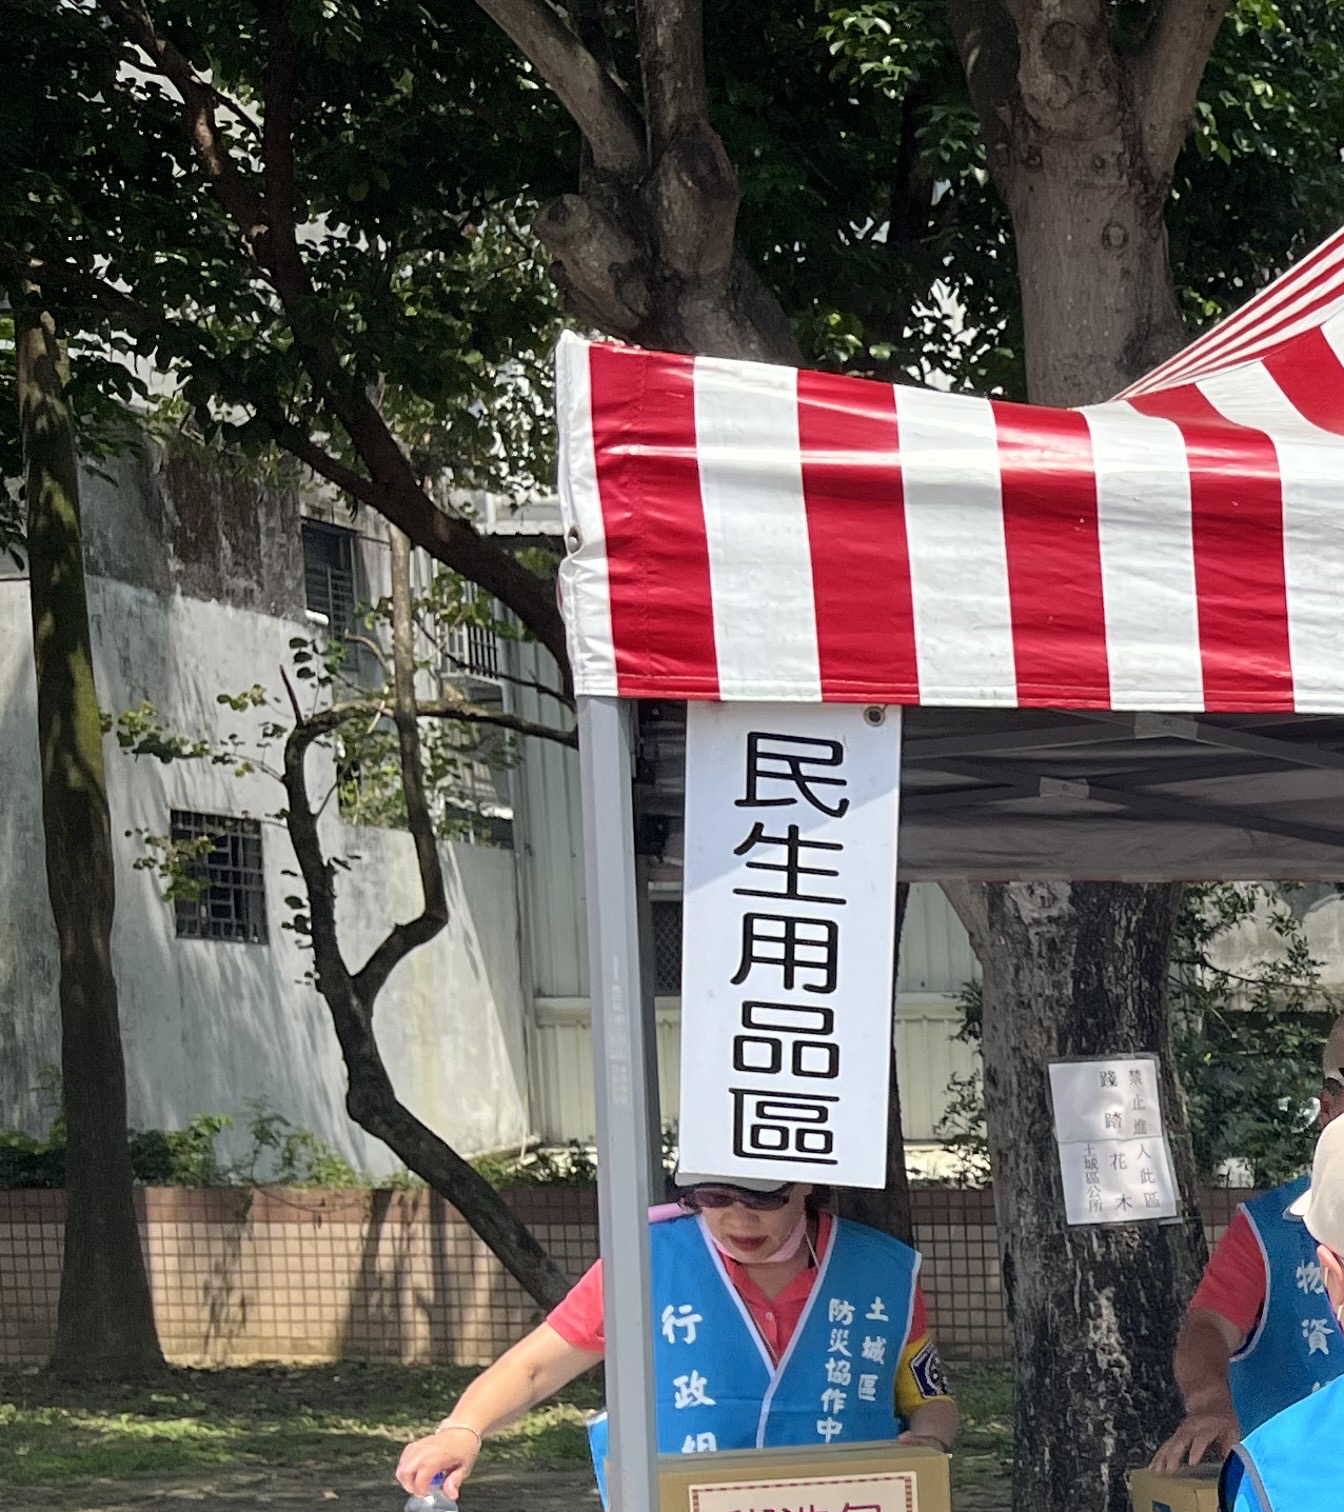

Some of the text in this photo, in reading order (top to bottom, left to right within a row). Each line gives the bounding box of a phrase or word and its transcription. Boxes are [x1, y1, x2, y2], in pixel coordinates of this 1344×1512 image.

[728, 731, 850, 1166] 民生用品區
[816, 1297, 856, 1444] 防災協作中
[858, 1295, 889, 1402] 土城區
[1296, 1258, 1336, 1393] 物資
